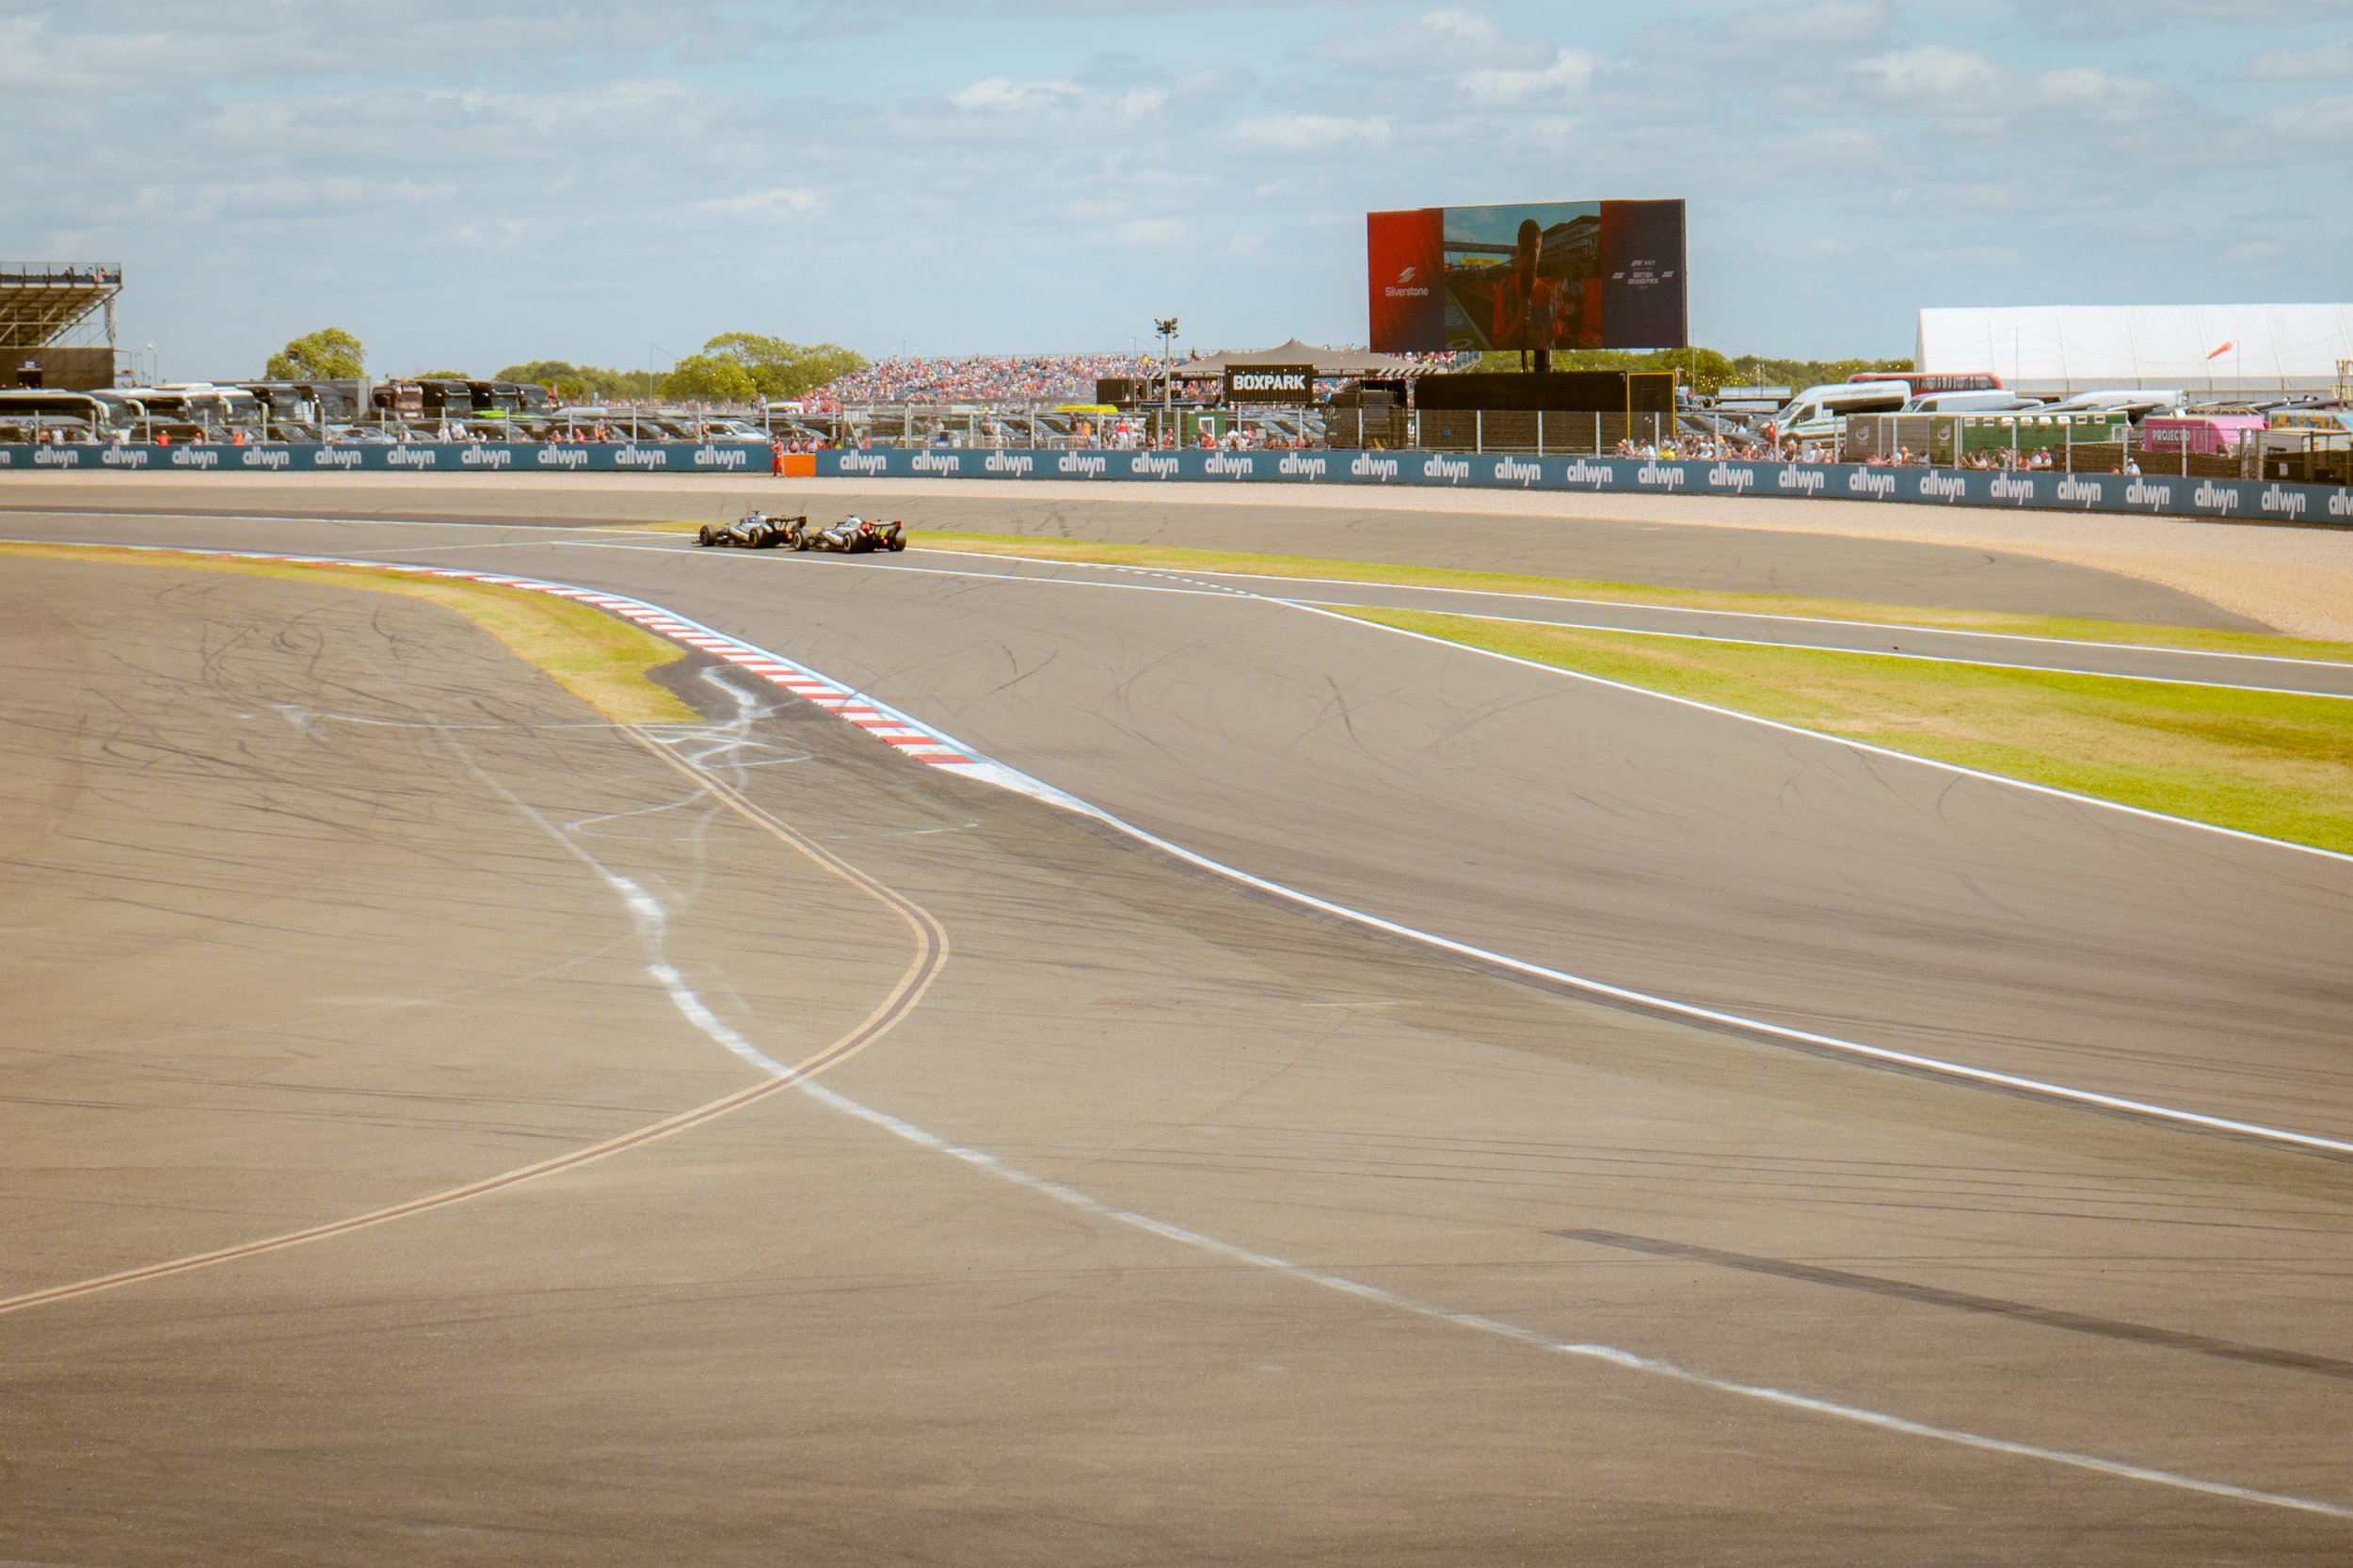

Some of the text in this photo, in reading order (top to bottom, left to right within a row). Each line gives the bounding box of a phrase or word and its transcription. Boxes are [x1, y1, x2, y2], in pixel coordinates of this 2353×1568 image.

[1385, 286, 1429, 296] Silverstone
[1233, 375, 1305, 391] BOXPARK
[35, 445, 78, 468] allwyn
[103, 444, 147, 468] allwyn
[172, 444, 217, 468] allwyn
[243, 443, 289, 469] allwyn
[315, 443, 361, 469] allwyn
[387, 443, 435, 469] allwyn
[461, 442, 510, 469] allwyn
[538, 442, 587, 469] allwyn
[615, 441, 665, 469] allwyn
[695, 441, 745, 468] allwyn
[840, 447, 887, 476] allwyn
[912, 448, 959, 477] allwyn
[984, 449, 1032, 478] allwyn
[1058, 449, 1106, 479] allwyn
[1131, 450, 1178, 480] allwyn
[1205, 450, 1253, 481] allwyn
[1279, 451, 1325, 481] allwyn
[1352, 451, 1398, 482] allwyn
[1424, 455, 1469, 484] allwyn
[1495, 456, 1541, 487] allwyn
[1567, 457, 1612, 489] allwyn
[1638, 459, 1684, 491] allwyn
[1708, 461, 1753, 493] allwyn
[1778, 463, 1824, 496] allwyn
[1849, 465, 1895, 498] allwyn
[1920, 470, 1965, 502] allwyn
[1991, 471, 2034, 505] allwyn
[2057, 474, 2101, 508] allwyn
[2126, 477, 2169, 512] allwyn
[2195, 480, 2238, 516] allwyn
[2262, 483, 2306, 520] allwyn
